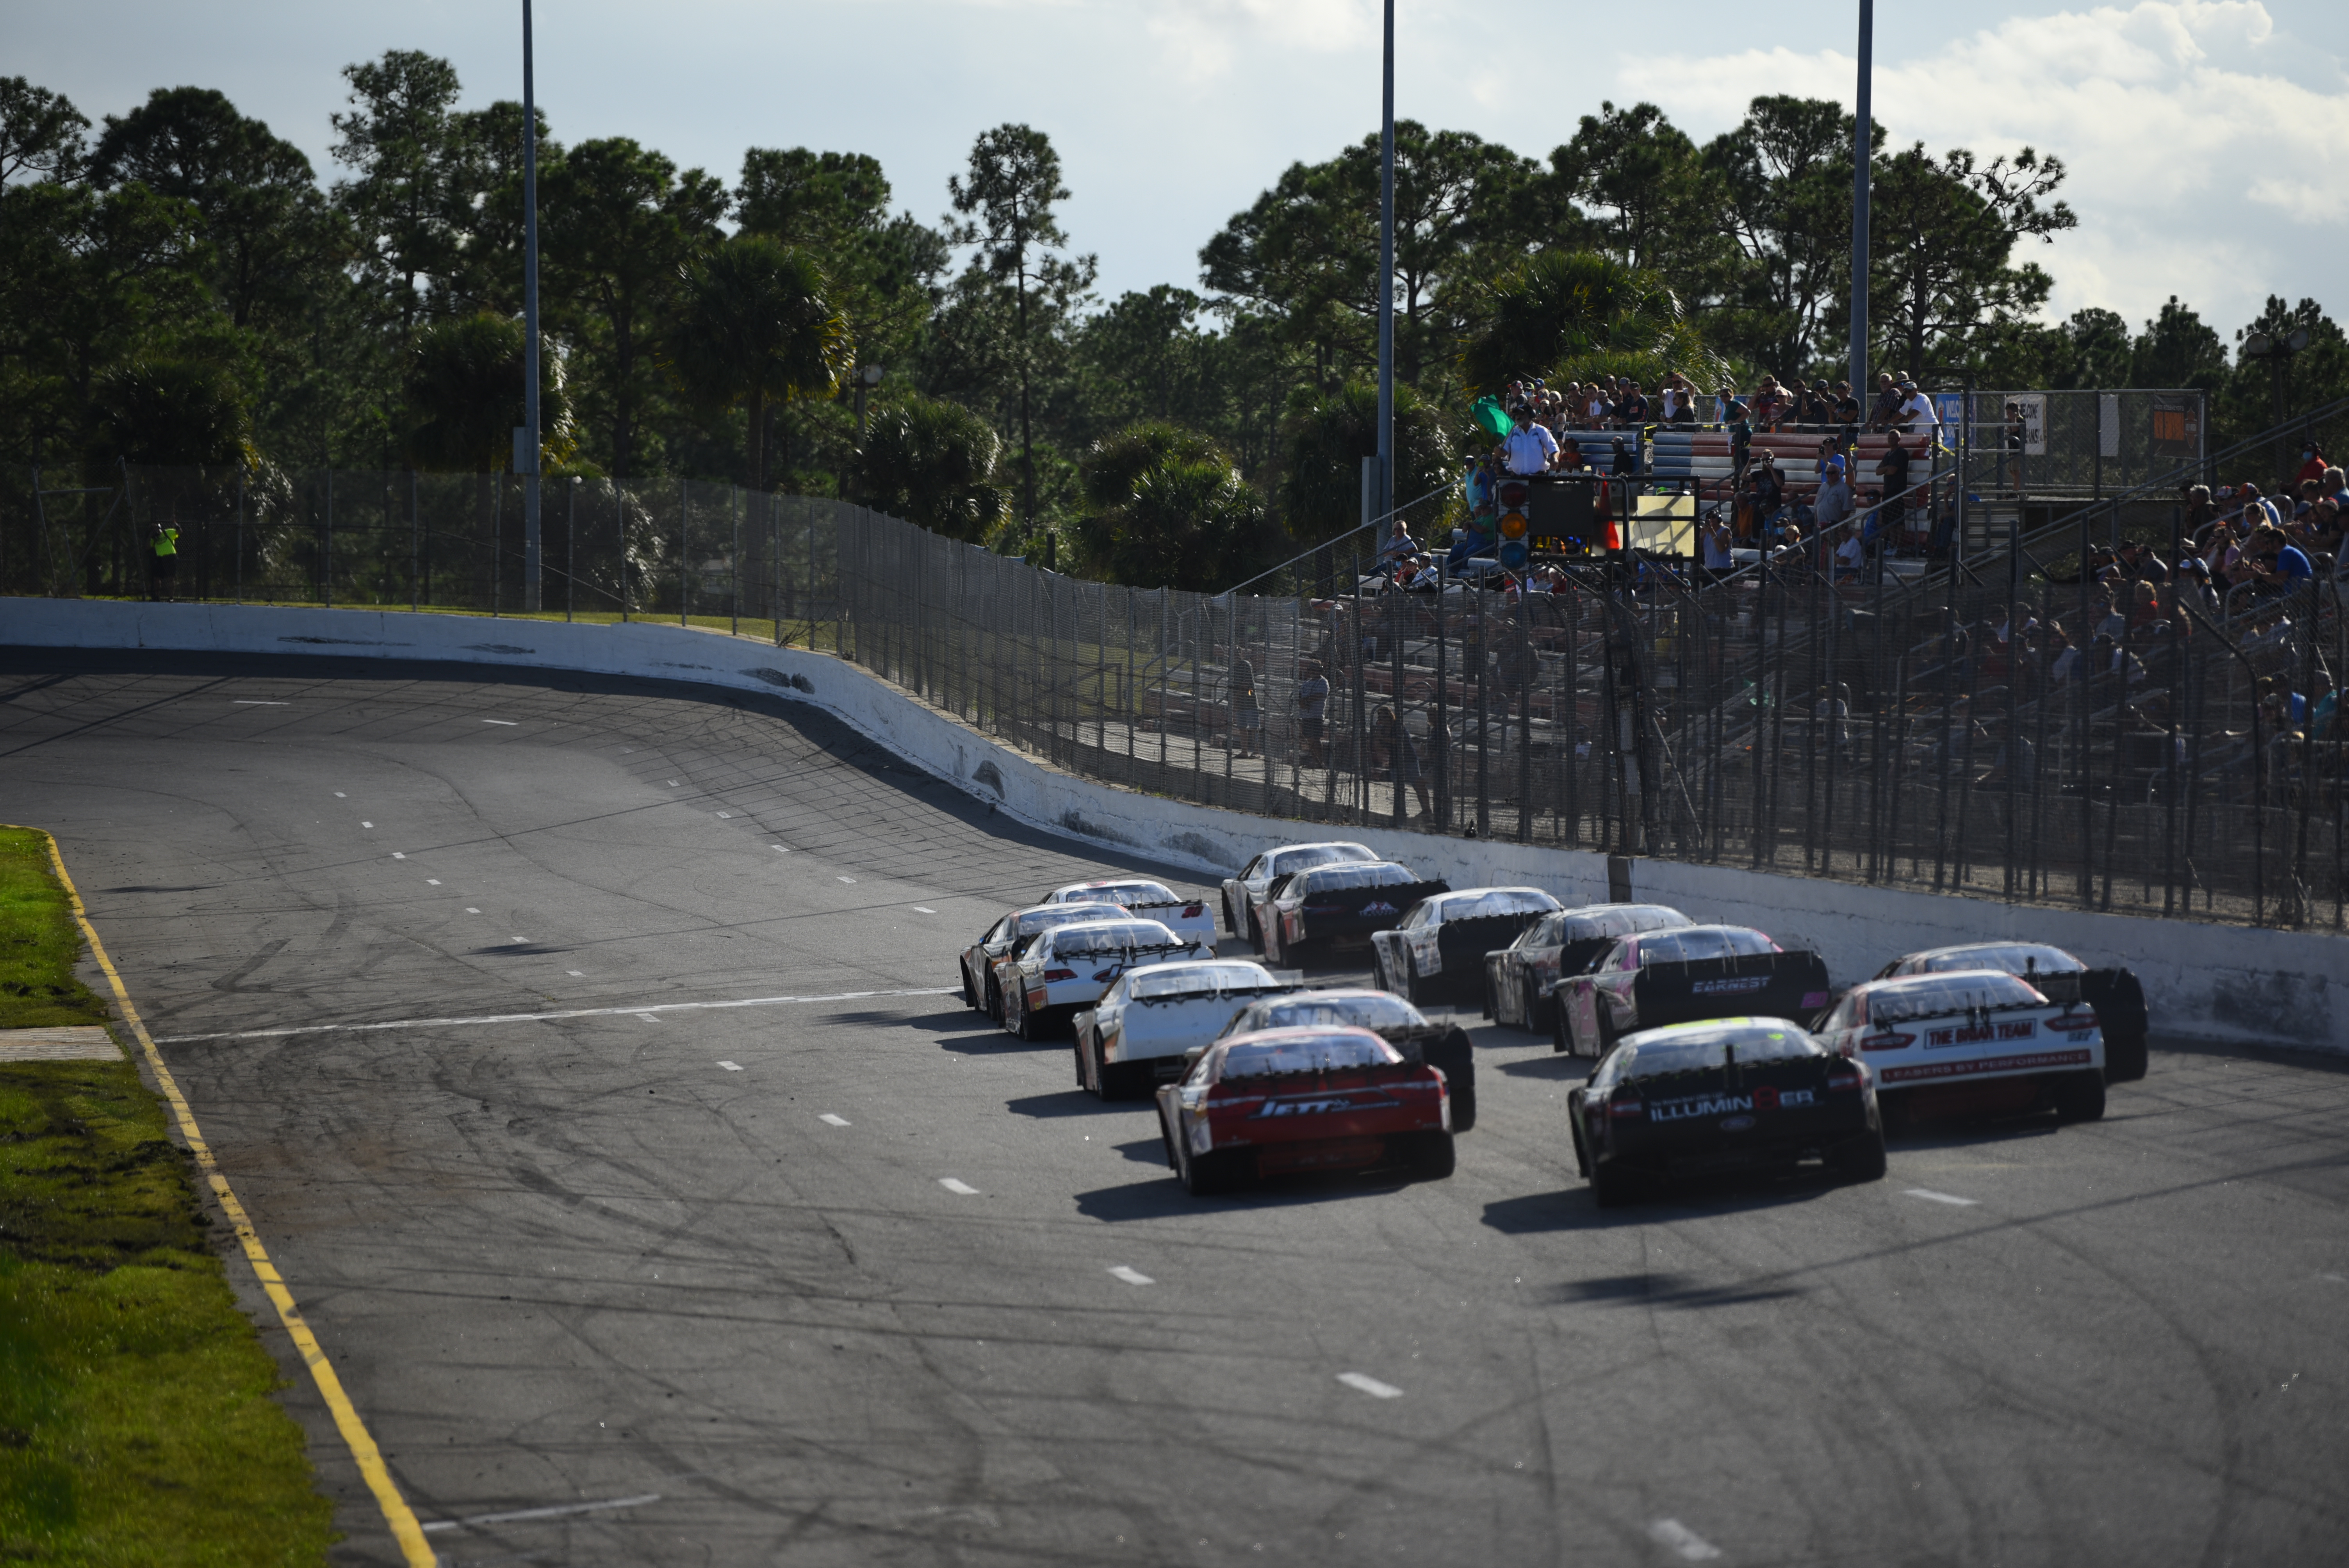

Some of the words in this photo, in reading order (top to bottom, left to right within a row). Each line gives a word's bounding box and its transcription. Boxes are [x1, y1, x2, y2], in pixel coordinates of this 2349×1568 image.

[1692, 975, 1773, 994] EARNEST
[1800, 991, 1829, 1009] 20
[1929, 1029, 1953, 1047] THE
[1956, 1025, 1994, 1043] BRIAR
[1998, 1022, 2032, 1042] TEAM
[1884, 1064, 1952, 1079] LEADERS
[1955, 1062, 1976, 1073] BY
[1978, 1052, 2087, 1070] PERFORMANCE
[1650, 1085, 1815, 1123] ILLUMIN8ER
